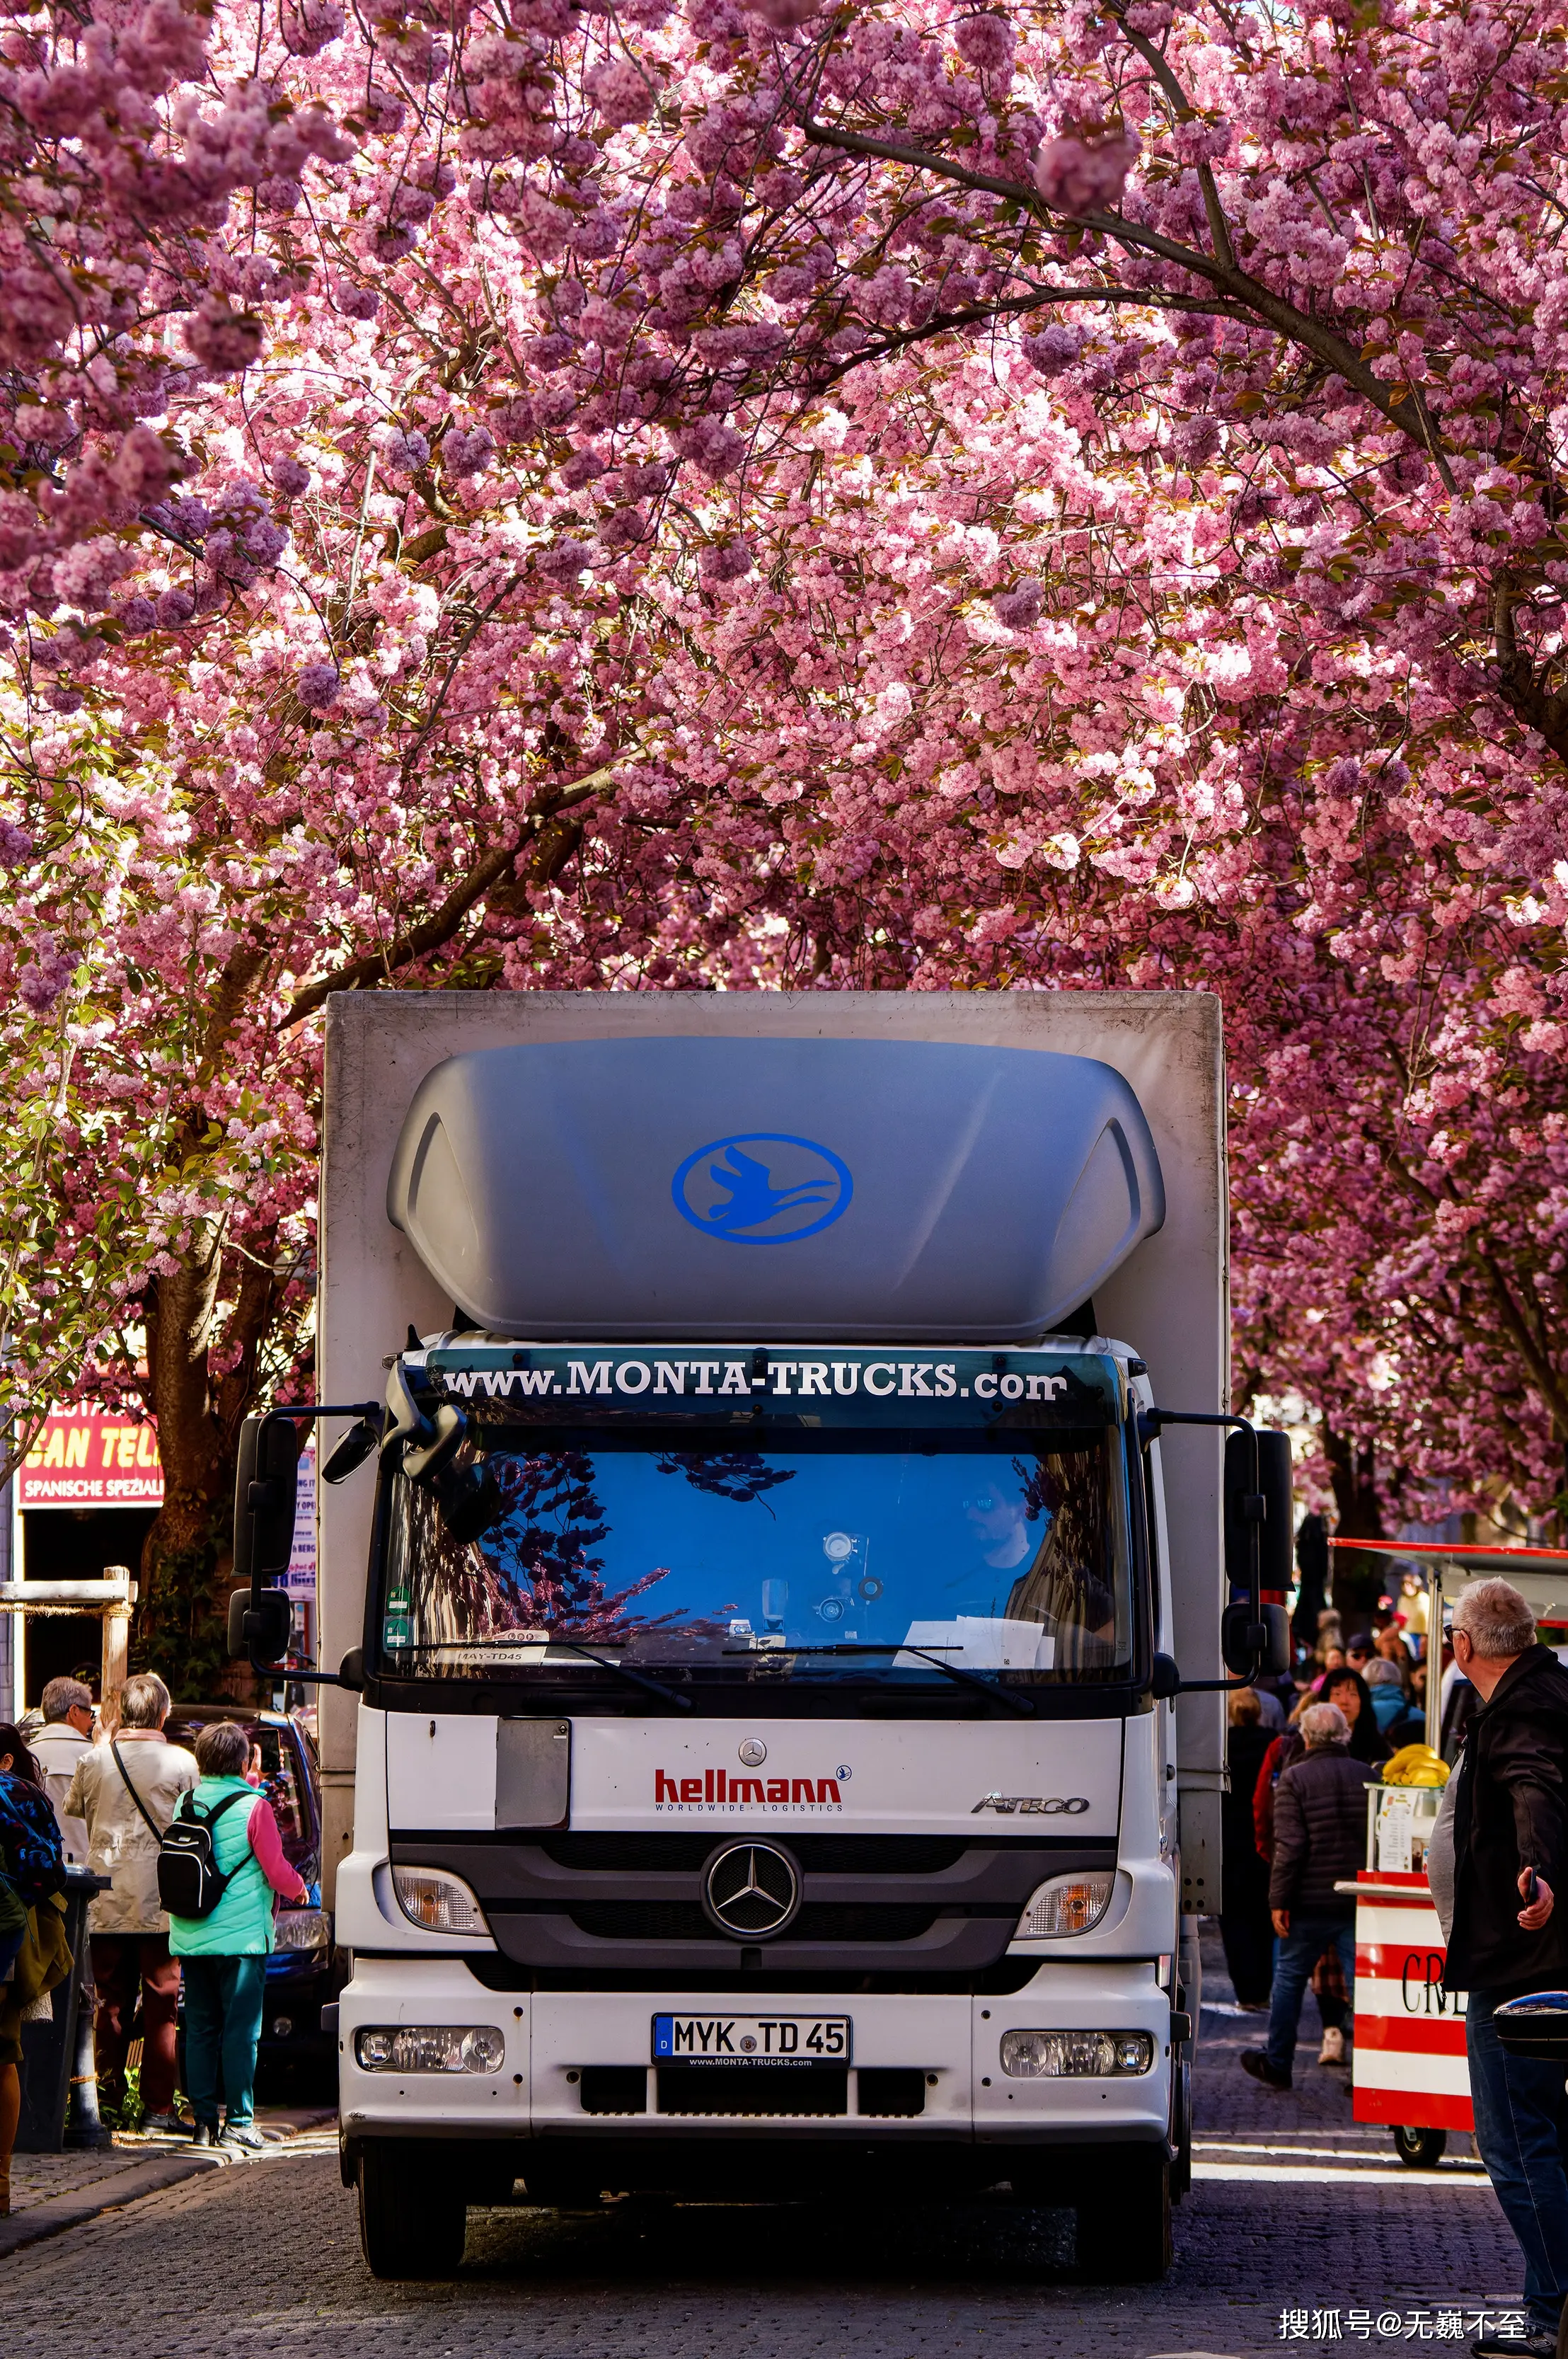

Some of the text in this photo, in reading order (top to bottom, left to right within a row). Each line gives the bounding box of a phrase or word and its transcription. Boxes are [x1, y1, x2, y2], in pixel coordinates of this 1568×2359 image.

[443, 1361, 1067, 1401] www.MONTA-TRUCKS.com
[25, 1427, 161, 1469] SAN TEL
[25, 1479, 103, 1497] SPANISCHE
[655, 1769, 842, 1803] hellmann
[970, 1789, 1090, 1814] ATEGO
[660, 2040, 667, 2049] D
[674, 2021, 844, 2053] MYK TD 45
[689, 2057, 812, 2067] www.MONTA-TRUCKS.com
